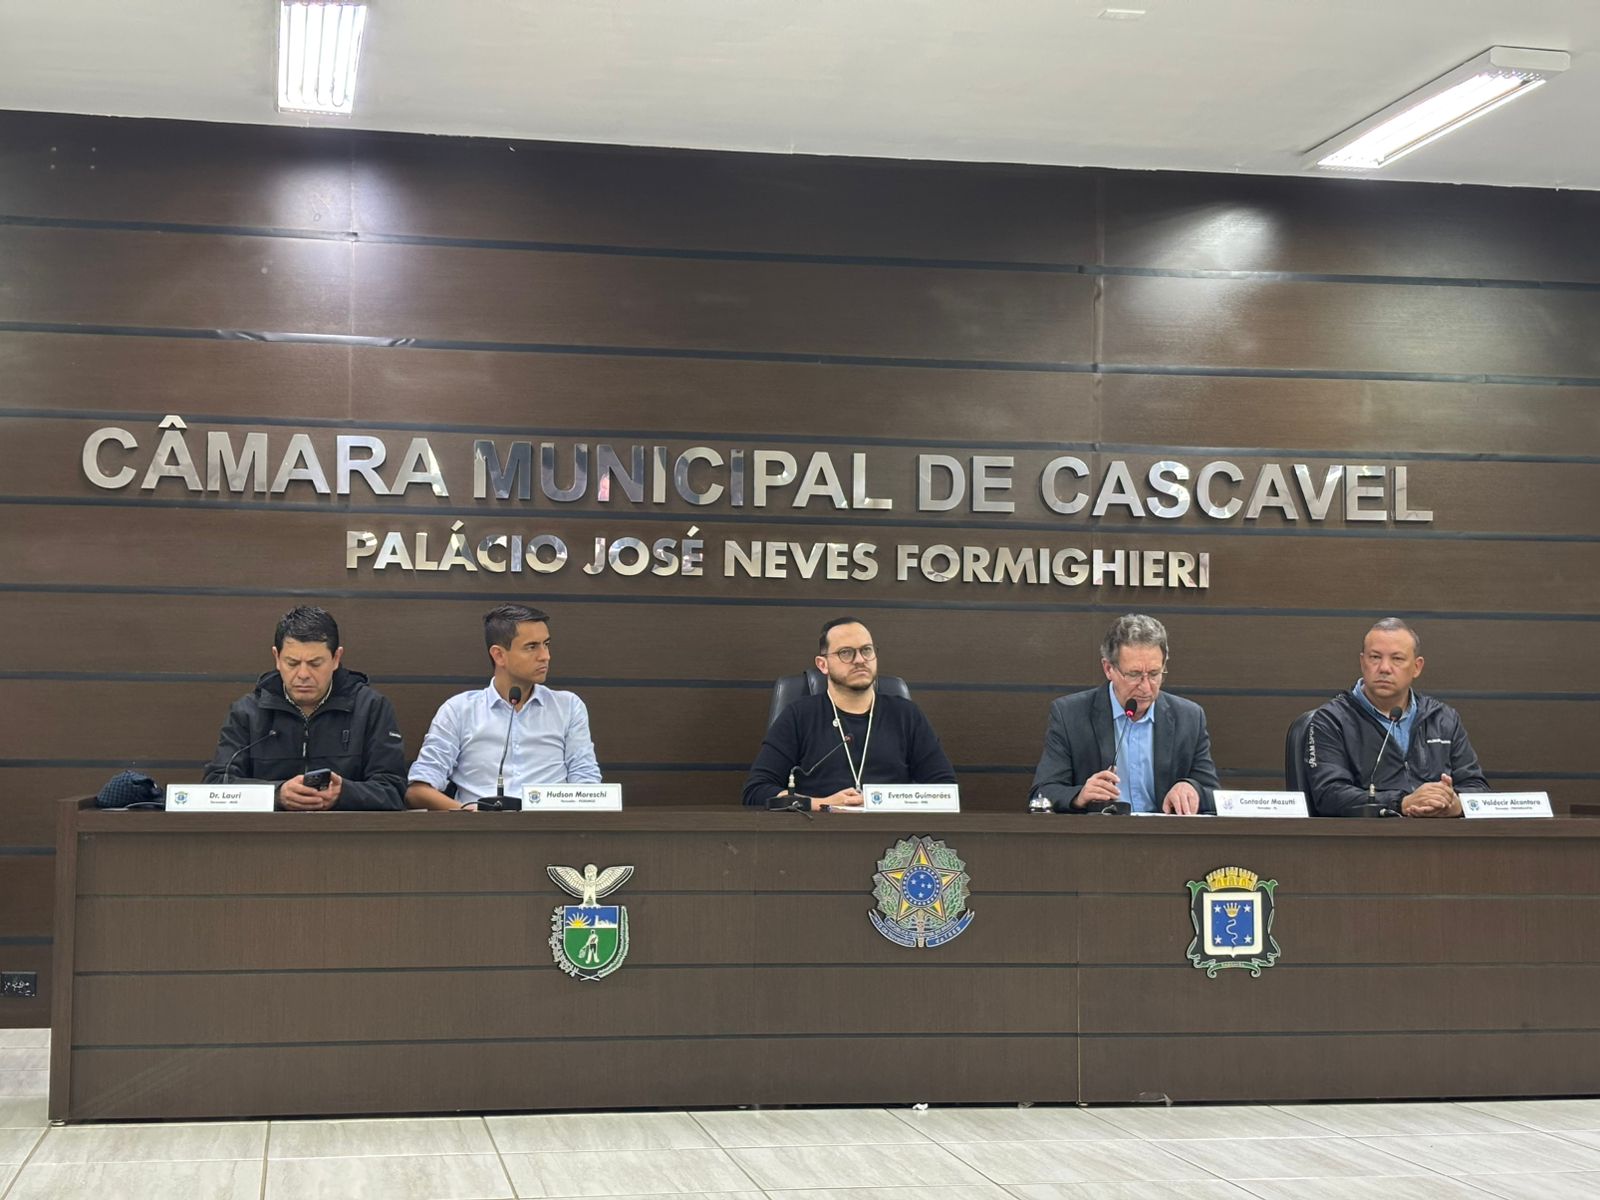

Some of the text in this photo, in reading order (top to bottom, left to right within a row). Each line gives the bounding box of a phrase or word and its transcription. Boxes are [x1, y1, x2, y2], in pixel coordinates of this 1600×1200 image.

[81, 414, 1434, 523] CÂMARA MUNICIPAL DE CASCAVEL
[346, 520, 1210, 589] PALÁCIO JOSÉ NEVES FORMIGHIERI
